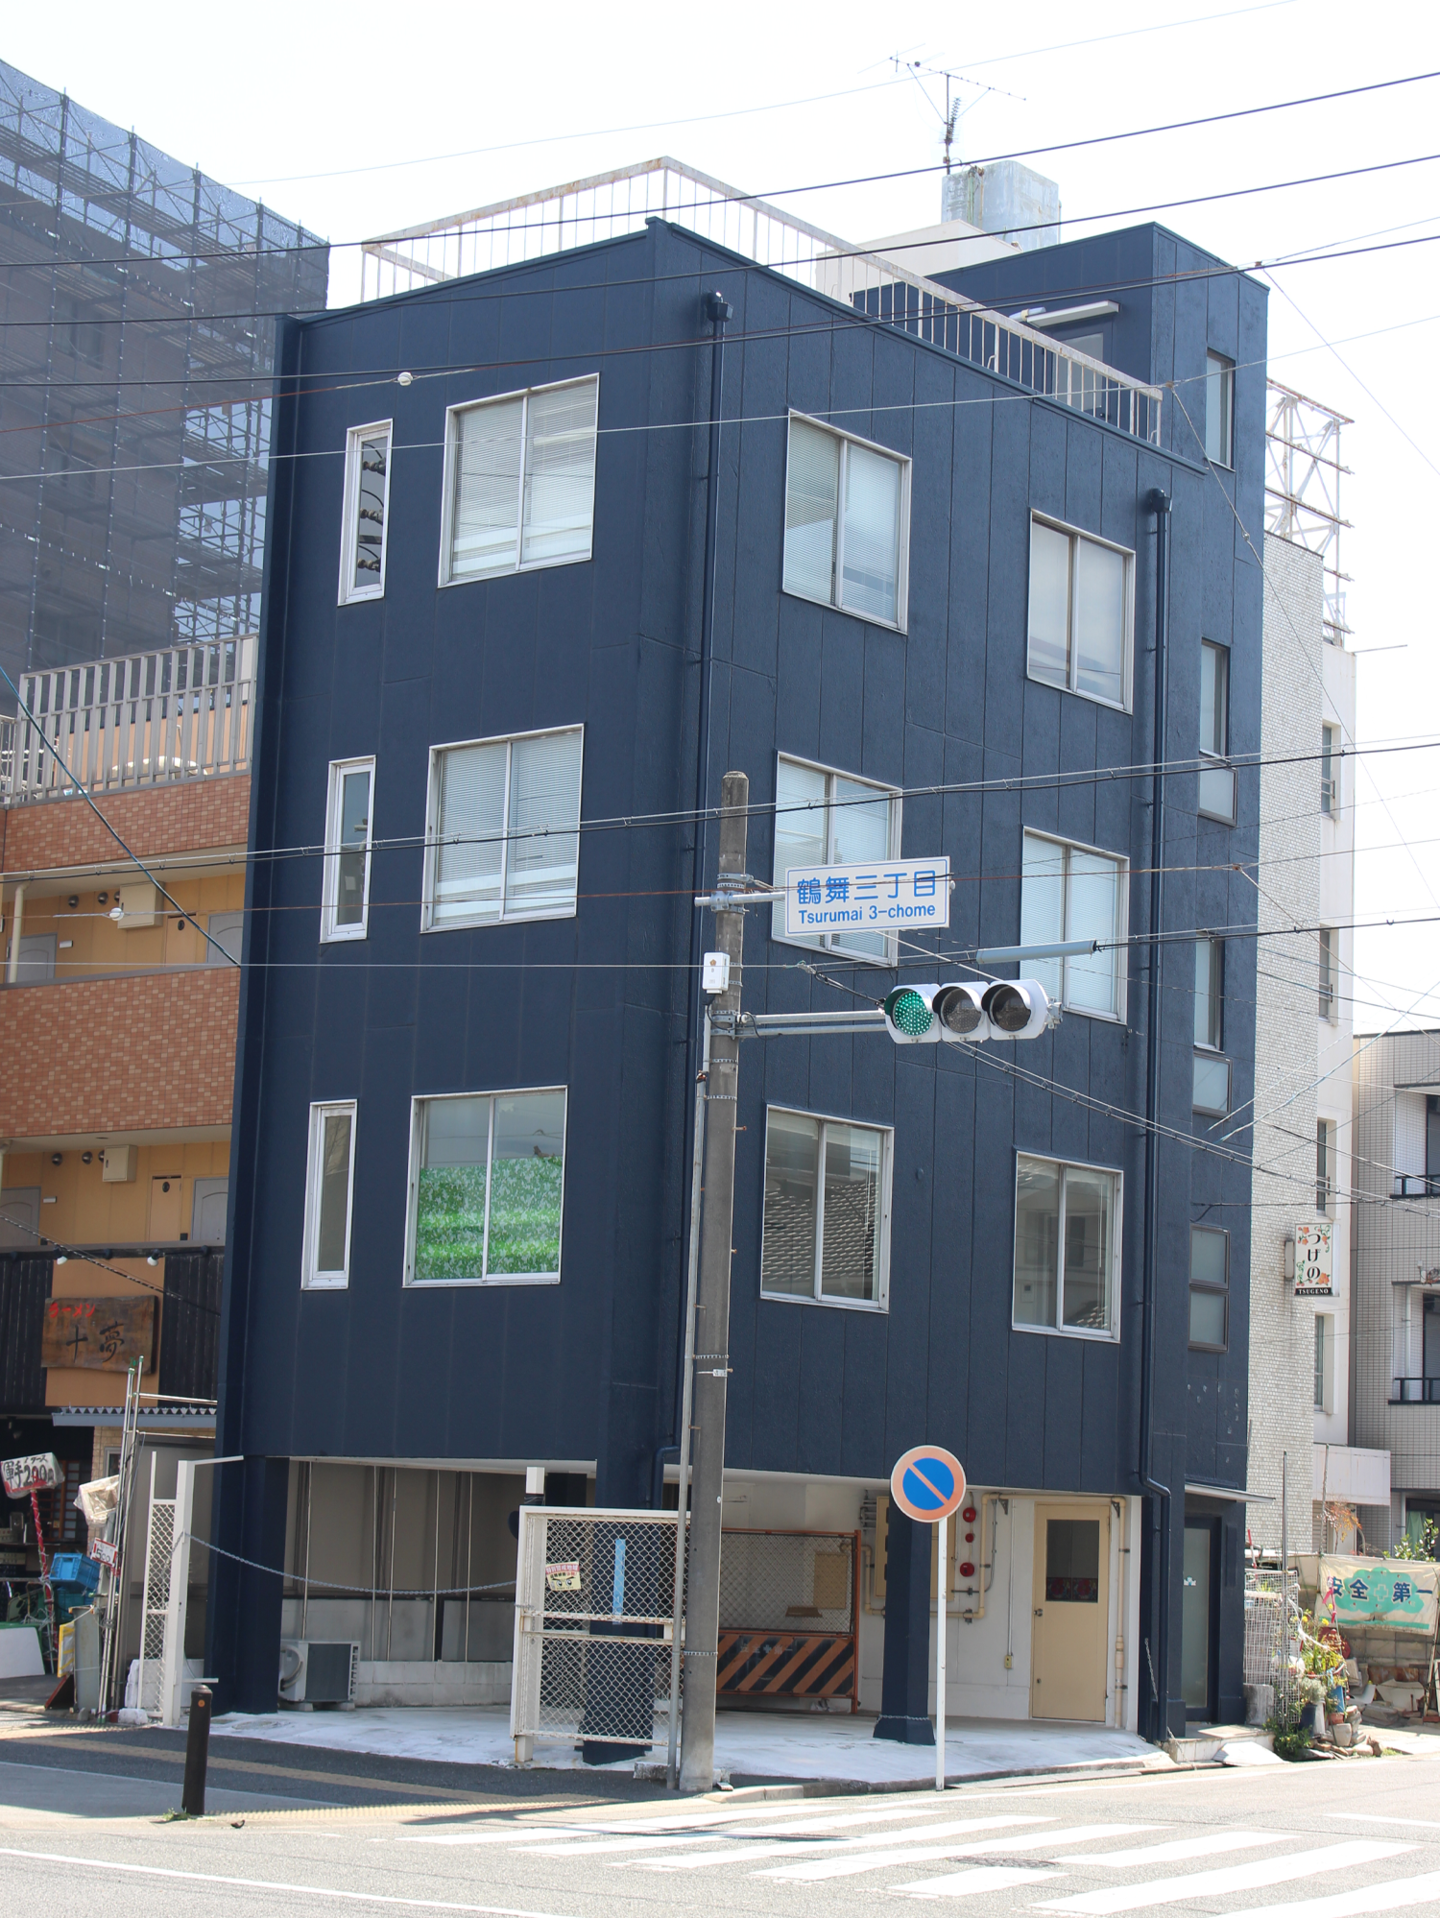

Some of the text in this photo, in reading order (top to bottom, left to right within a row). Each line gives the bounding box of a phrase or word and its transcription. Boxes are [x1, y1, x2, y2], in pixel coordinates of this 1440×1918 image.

[797, 870, 936, 905] 鶴舞三丁目
[798, 903, 936, 924] Tsurumai 3-chome
[1307, 1233, 1322, 1280] つげの
[49, 1302, 95, 1318] ラーメン
